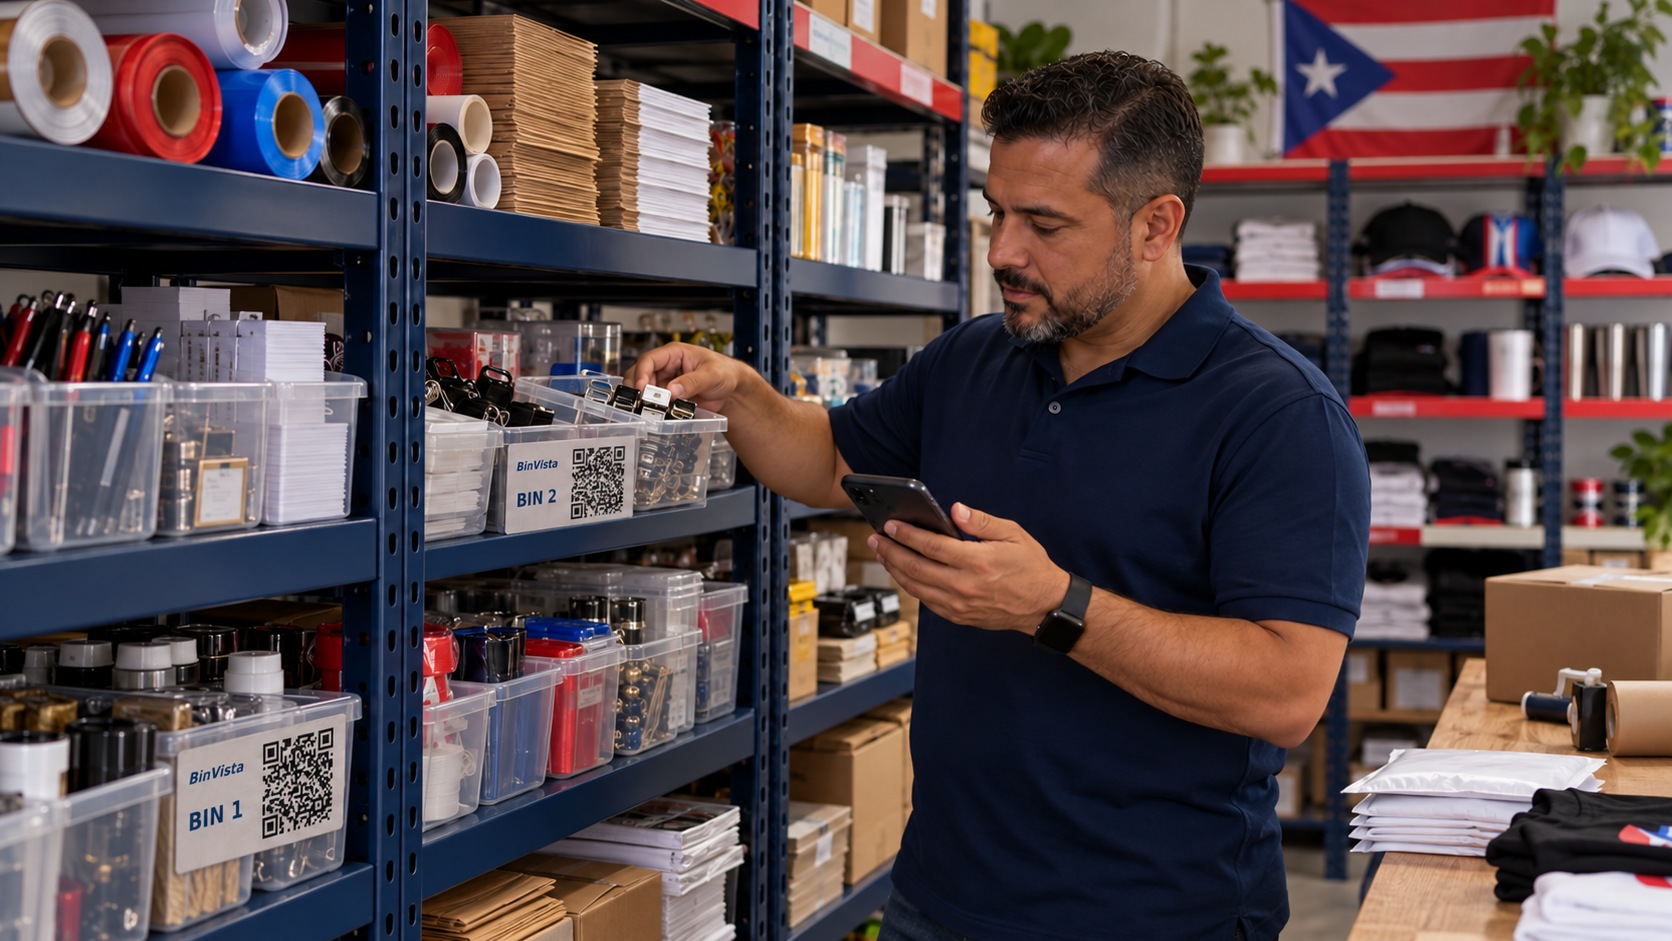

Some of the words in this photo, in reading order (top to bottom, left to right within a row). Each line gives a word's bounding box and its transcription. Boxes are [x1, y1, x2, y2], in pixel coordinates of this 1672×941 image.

[516, 459, 558, 471] BinVista
[517, 490, 543, 508] BIN
[548, 488, 557, 504] 2
[189, 762, 244, 785] BinVista
[189, 804, 224, 832] BIN
[232, 800, 243, 820] 1
